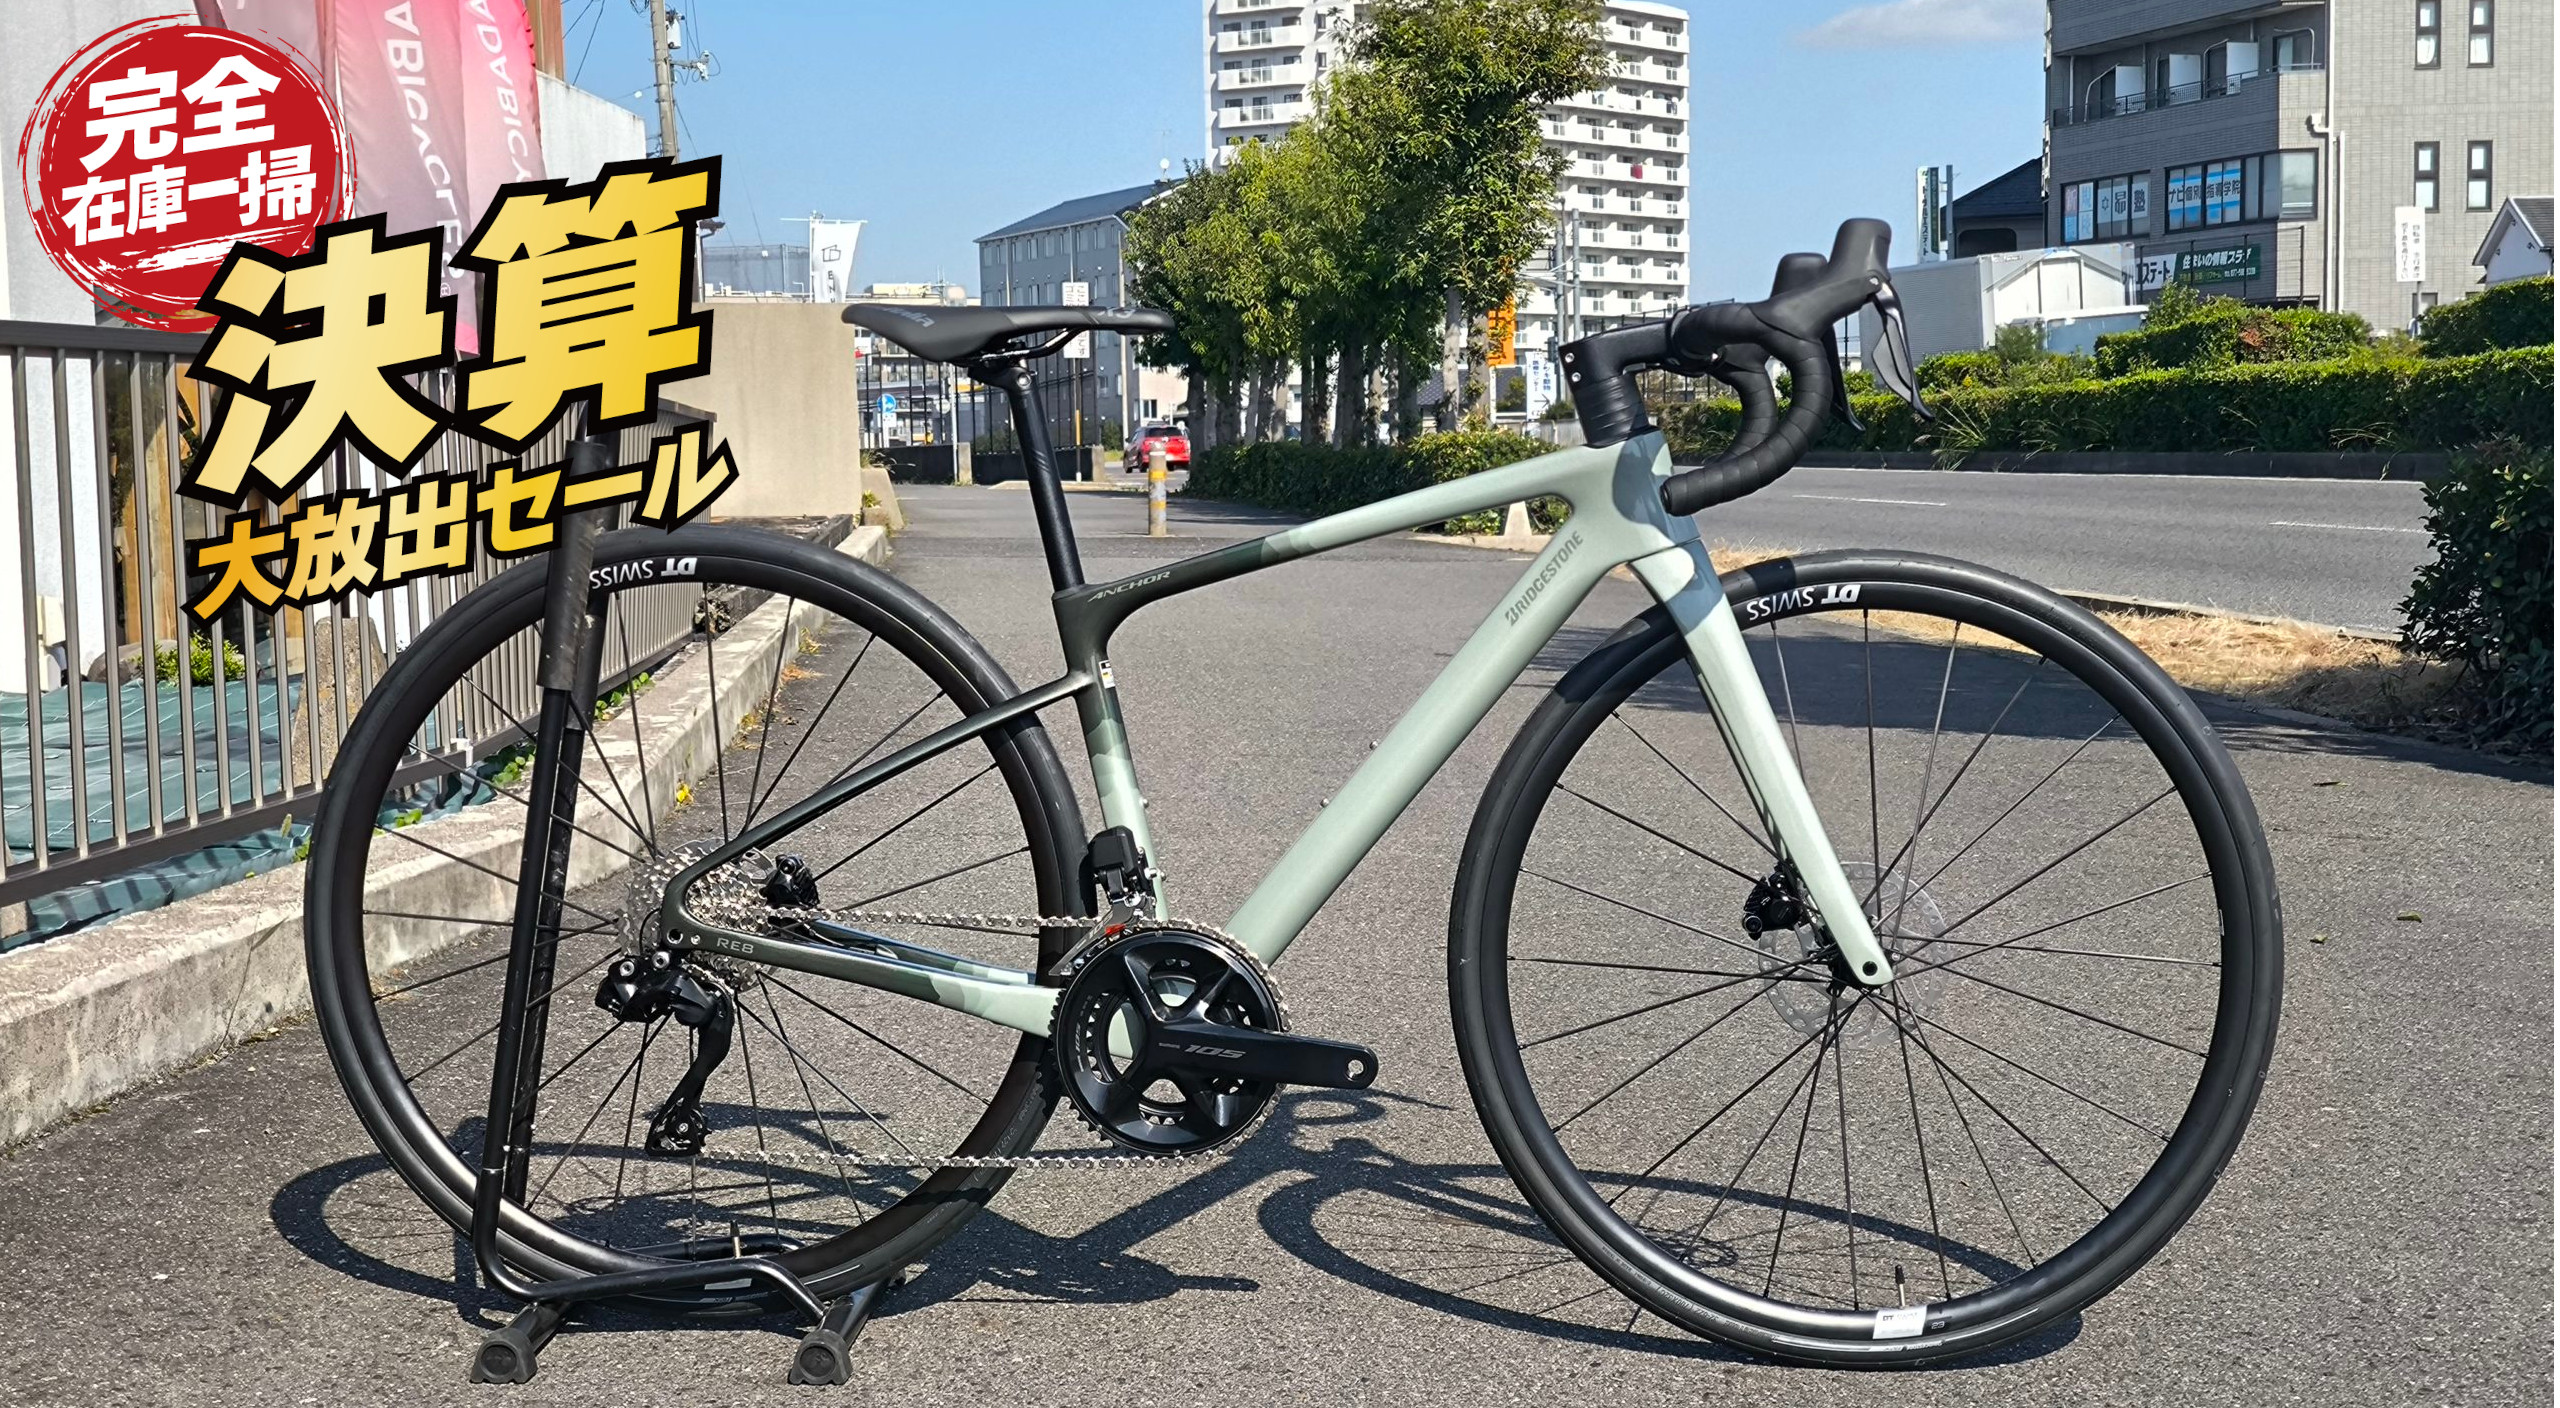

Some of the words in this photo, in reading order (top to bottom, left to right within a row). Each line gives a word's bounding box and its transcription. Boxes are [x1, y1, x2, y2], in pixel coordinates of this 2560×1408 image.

[588, 560, 654, 589] SWISS
[661, 557, 698, 577] DT
[1504, 531, 1584, 627] BRIDGESTONE
[1087, 571, 1171, 603] ANCHOR
[1820, 584, 1862, 605] DT
[1746, 587, 1816, 621] SWISS
[716, 937, 755, 954] RE8
[1184, 1044, 1247, 1060] 105
